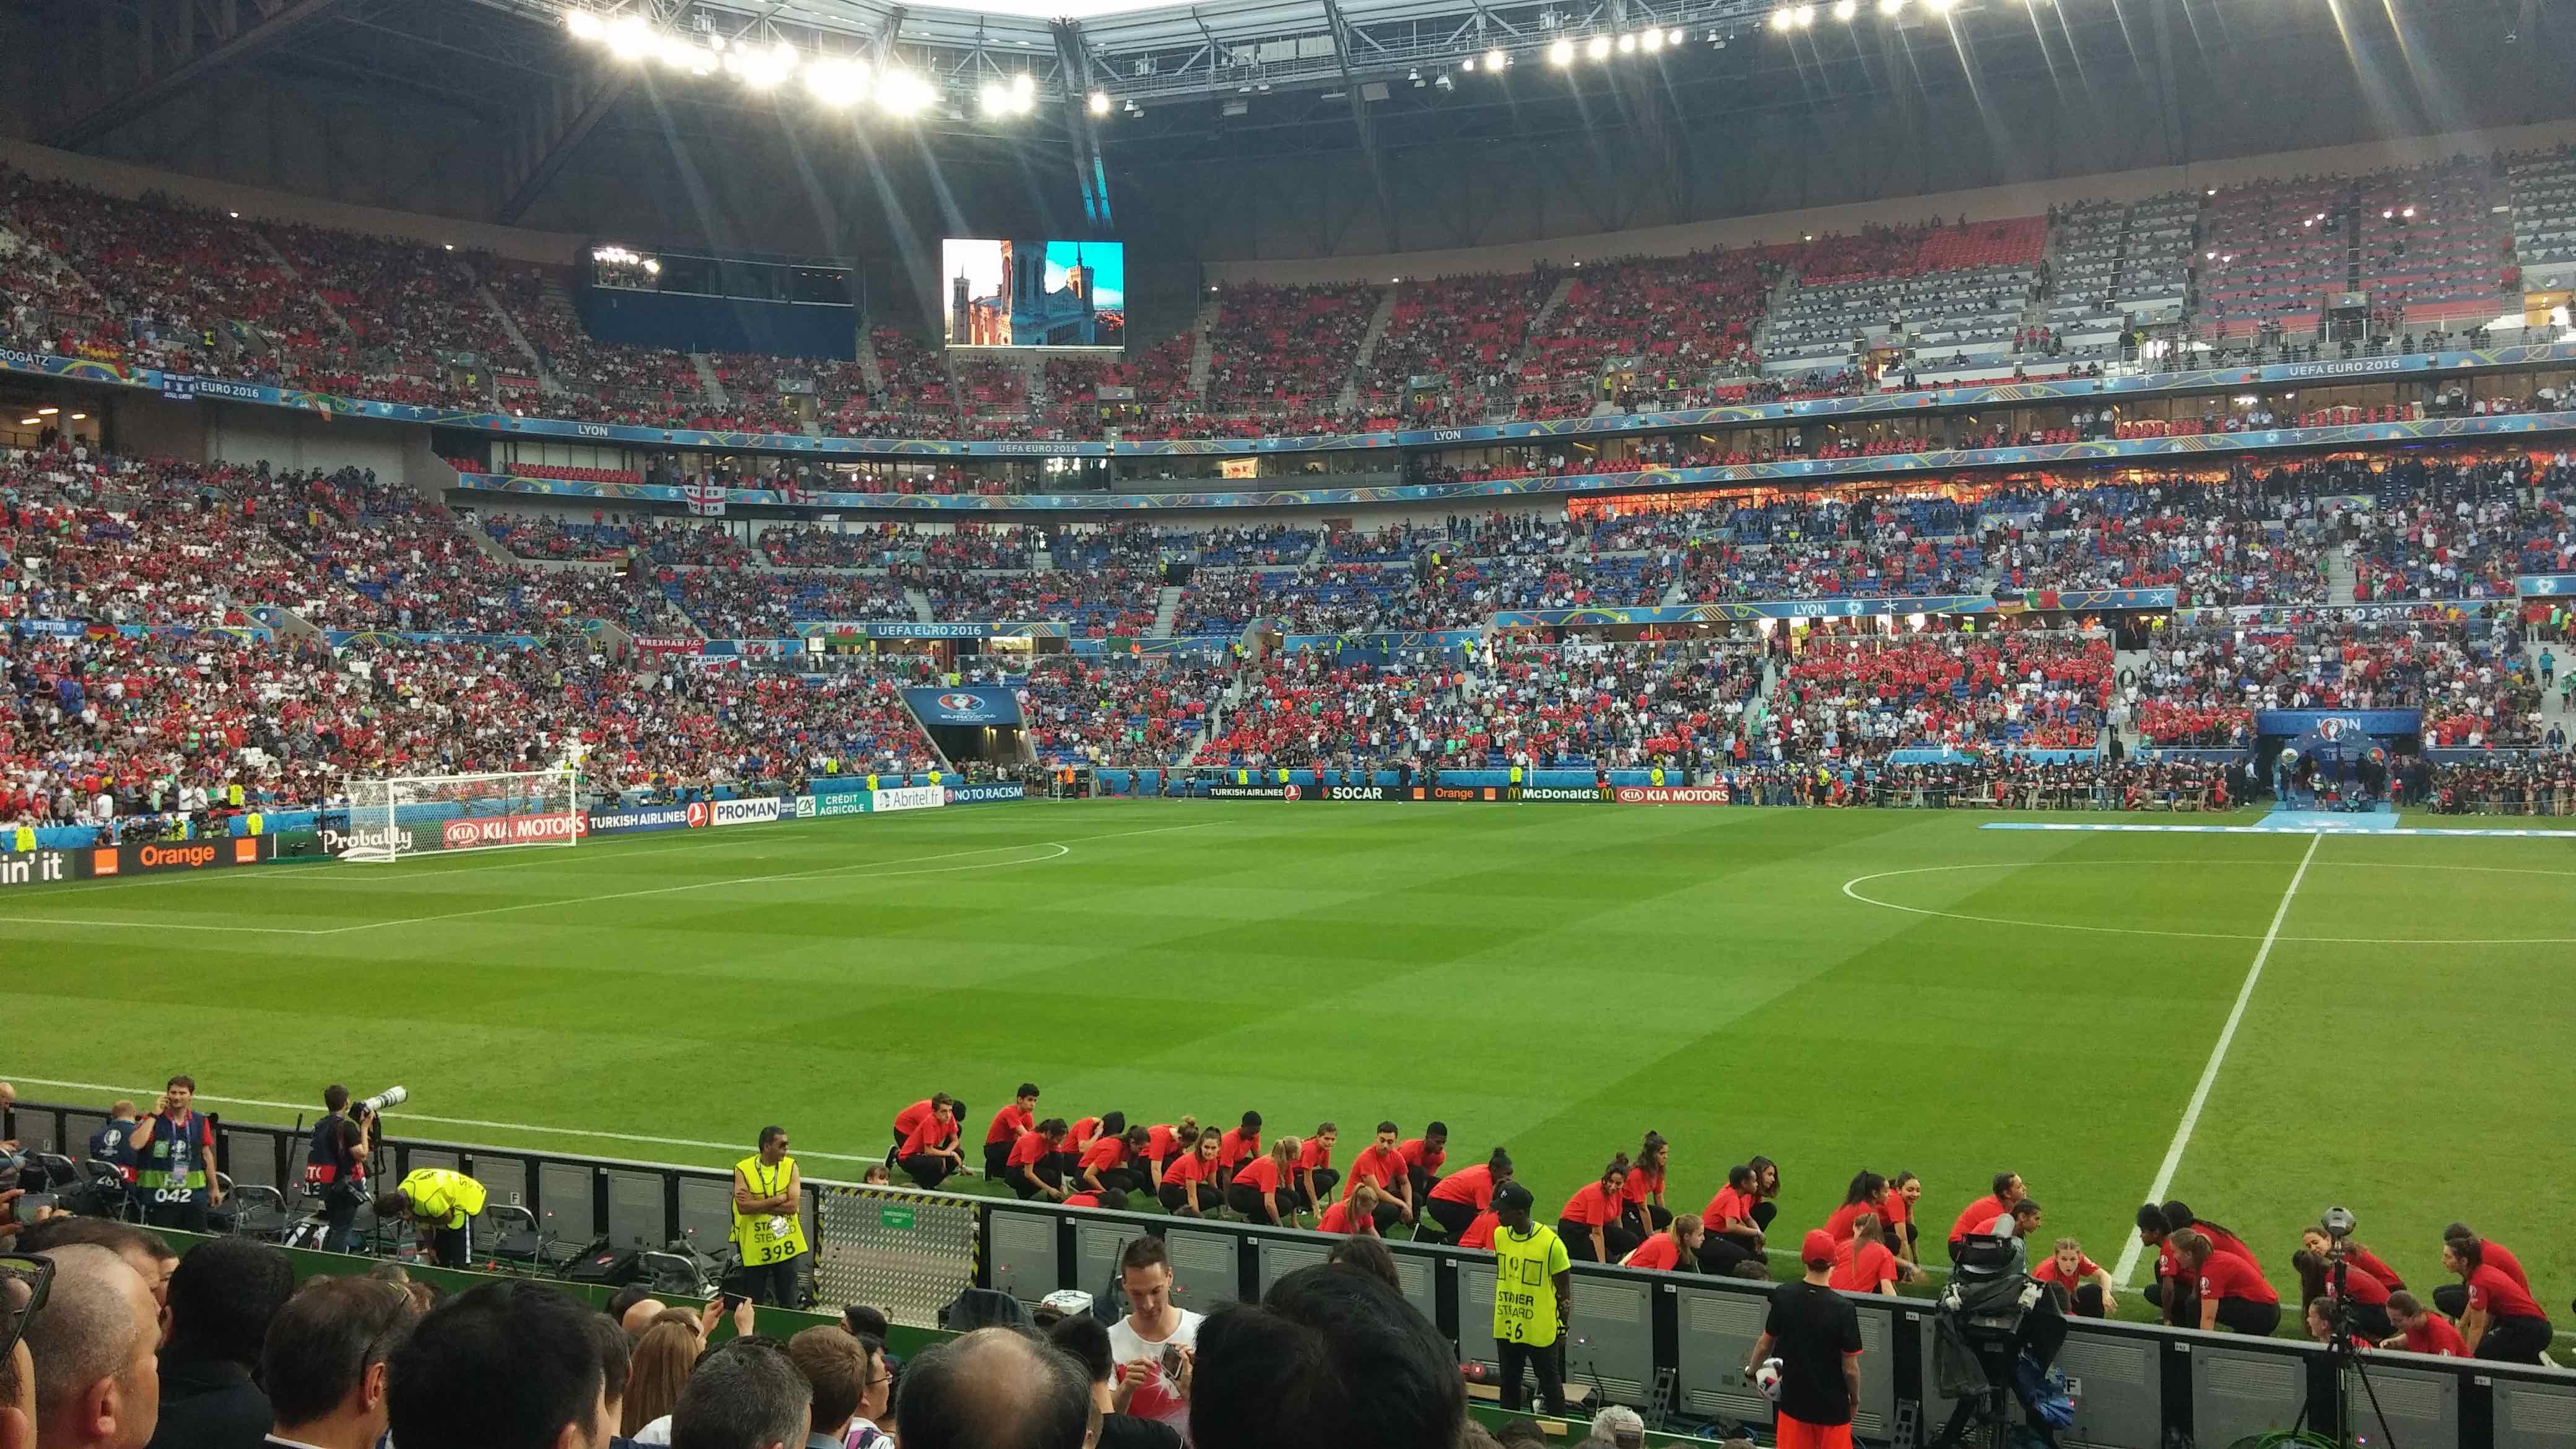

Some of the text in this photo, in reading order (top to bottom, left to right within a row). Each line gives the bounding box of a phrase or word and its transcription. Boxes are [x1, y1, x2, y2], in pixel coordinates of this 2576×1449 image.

[2290, 360, 2400, 376] UEFA EURO 2016
[201, 382, 259, 398] EURO 2016
[578, 425, 608, 437] LYON
[1434, 430, 1461, 441] LYON
[998, 445, 1077, 453] UEFA EURO 2016
[1794, 603, 1827, 615] LYON
[877, 625, 982, 635] UEFA EURO 2016
[638, 638, 685, 648] WREXHAM
[894, 788, 939, 807] Abritel.fr
[954, 786, 1023, 801] NO TO RACISM
[1210, 788, 1284, 796] TURKISH AIRLINES
[1332, 786, 1383, 799] SOCAR
[1434, 788, 1474, 800] Orange
[1522, 788, 1599, 799] McDonald's
[1623, 789, 1730, 801] KIA KIA MOTORS
[717, 803, 777, 820] PROMAN
[819, 803, 864, 817] AGRICOLE
[590, 810, 686, 830] TURKISH AIRLINES
[451, 816, 585, 839] KIA KIA MOTORS
[317, 827, 412, 853] Probably
[140, 844, 215, 867] Orange
[41, 851, 64, 881] it
[154, 1188, 193, 1203] 042
[761, 1240, 796, 1262] 398
[2067, 1379, 2077, 1393] F
